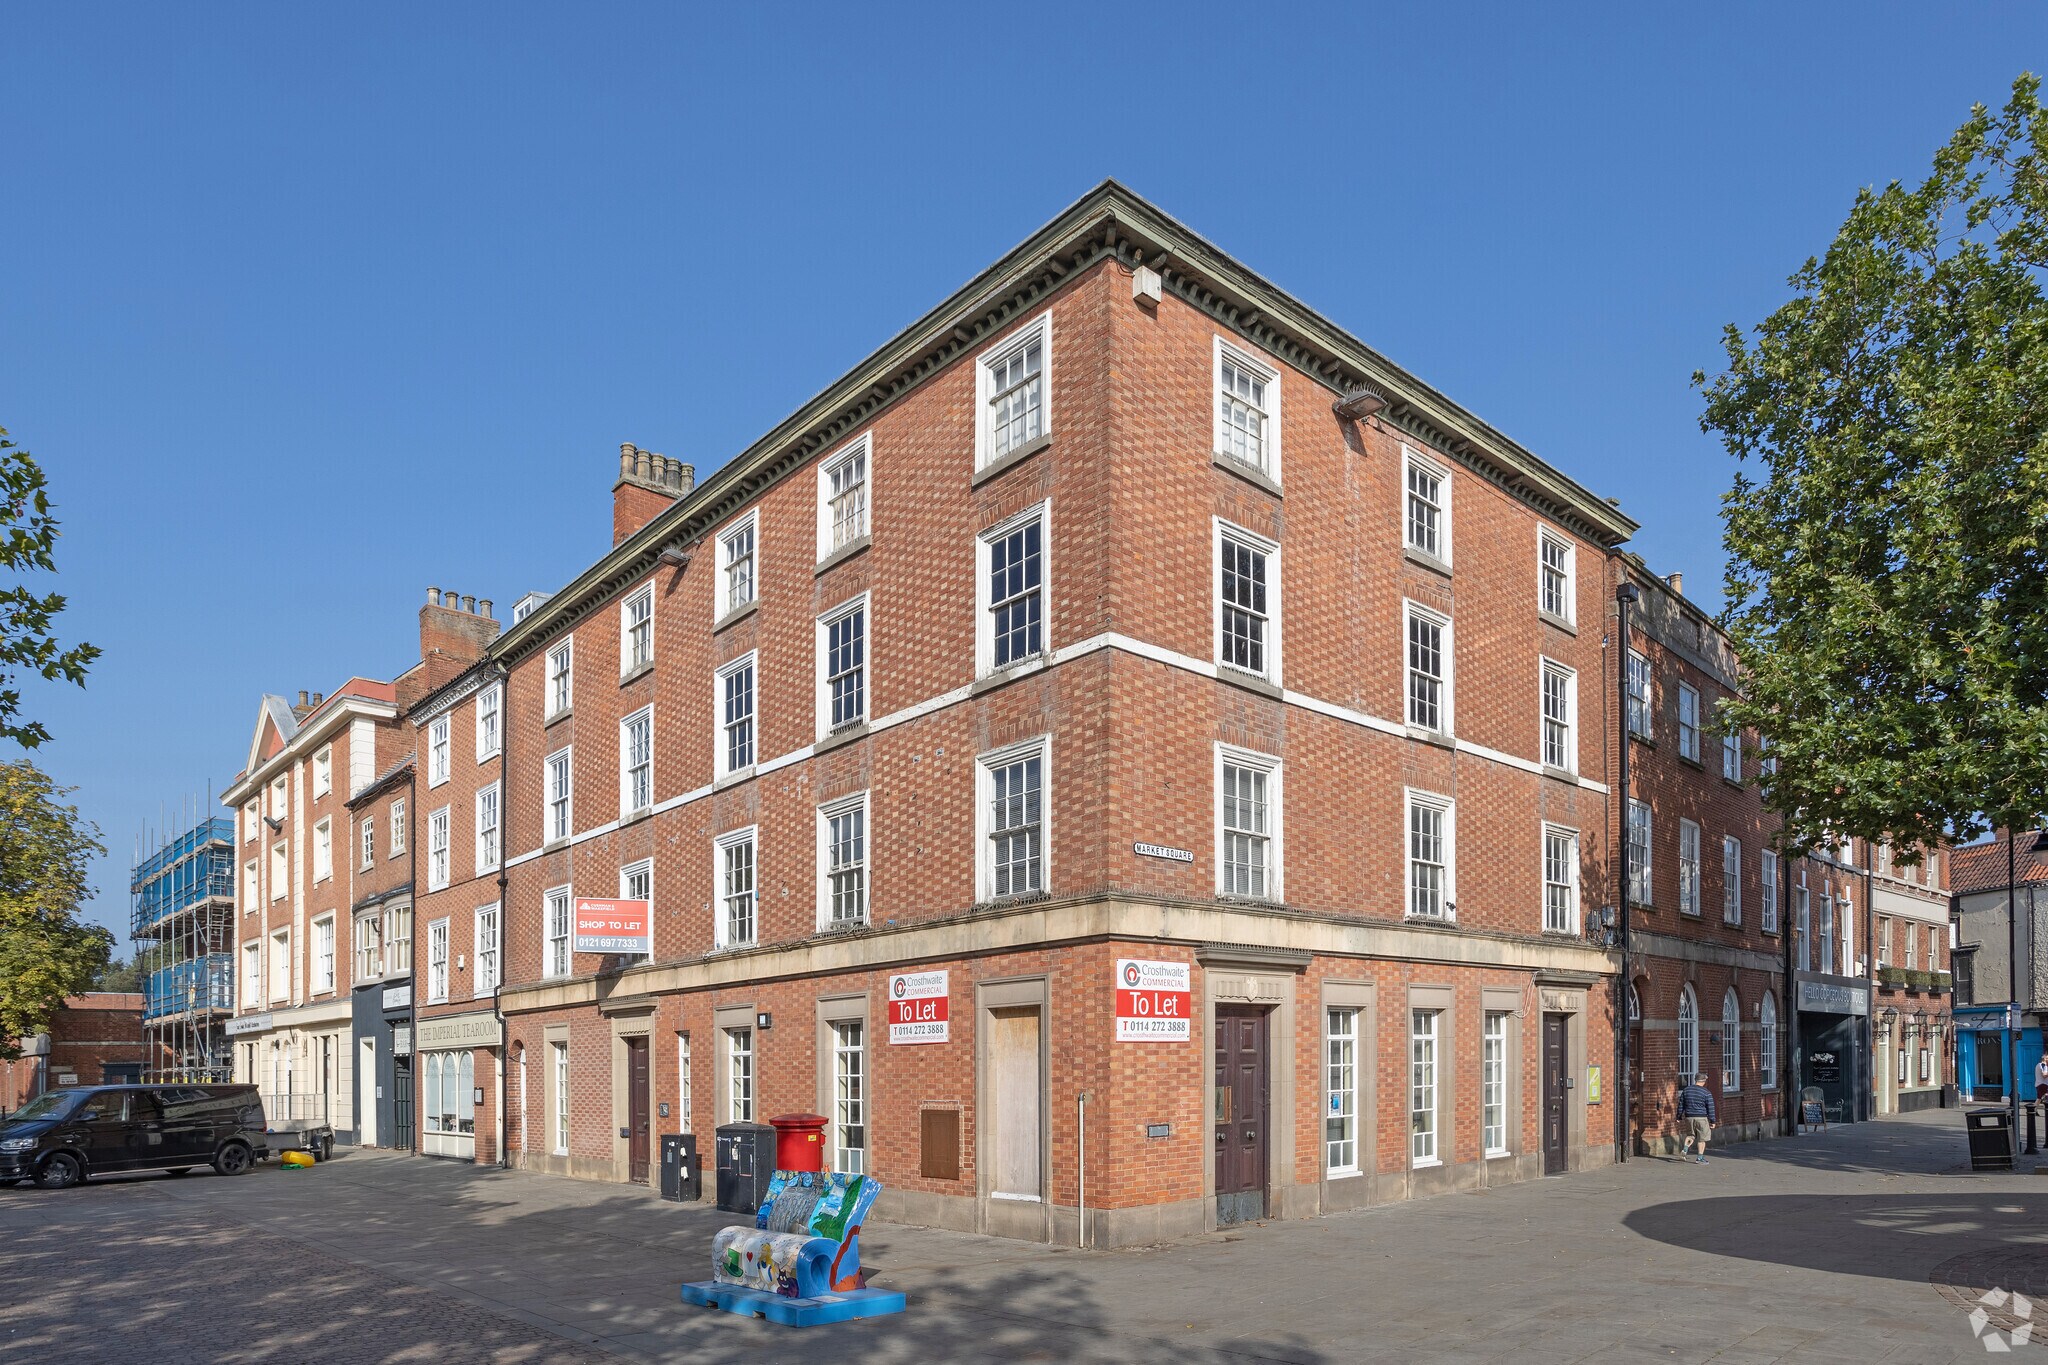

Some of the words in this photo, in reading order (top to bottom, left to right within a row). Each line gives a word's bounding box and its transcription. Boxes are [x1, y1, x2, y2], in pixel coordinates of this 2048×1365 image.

[1136, 844, 1164, 855] MARKET
[1166, 849, 1191, 860] SQUARE
[579, 920, 605, 929] SHOP
[608, 921, 622, 929] TO
[624, 922, 641, 930] LET
[1142, 964, 1184, 978] Crosthwaite
[907, 975, 942, 986] Crosthwaite
[1142, 978, 1184, 987] COMMERCIAL
[907, 987, 942, 995] COMMERCIAL
[1804, 986, 1820, 999] HELLO
[1129, 992, 1149, 1015] To
[1154, 992, 1178, 1016] Let
[897, 1001, 912, 1021] To
[916, 1000, 936, 1020] Let
[420, 1027, 431, 1041] THE
[432, 1025, 460, 1040] IMPERIAL
[462, 1020, 497, 1038] TEAROOM
[894, 1026, 897, 1036] T
[898, 1026, 912, 1036] 0114
[914, 1025, 925, 1035] 272
[927, 1024, 944, 1034] 3888
[1123, 1021, 1128, 1031] T
[1130, 1021, 1149, 1031] 0114
[1151, 1021, 1165, 1031] 272
[1167, 1021, 1186, 1032] 3888
